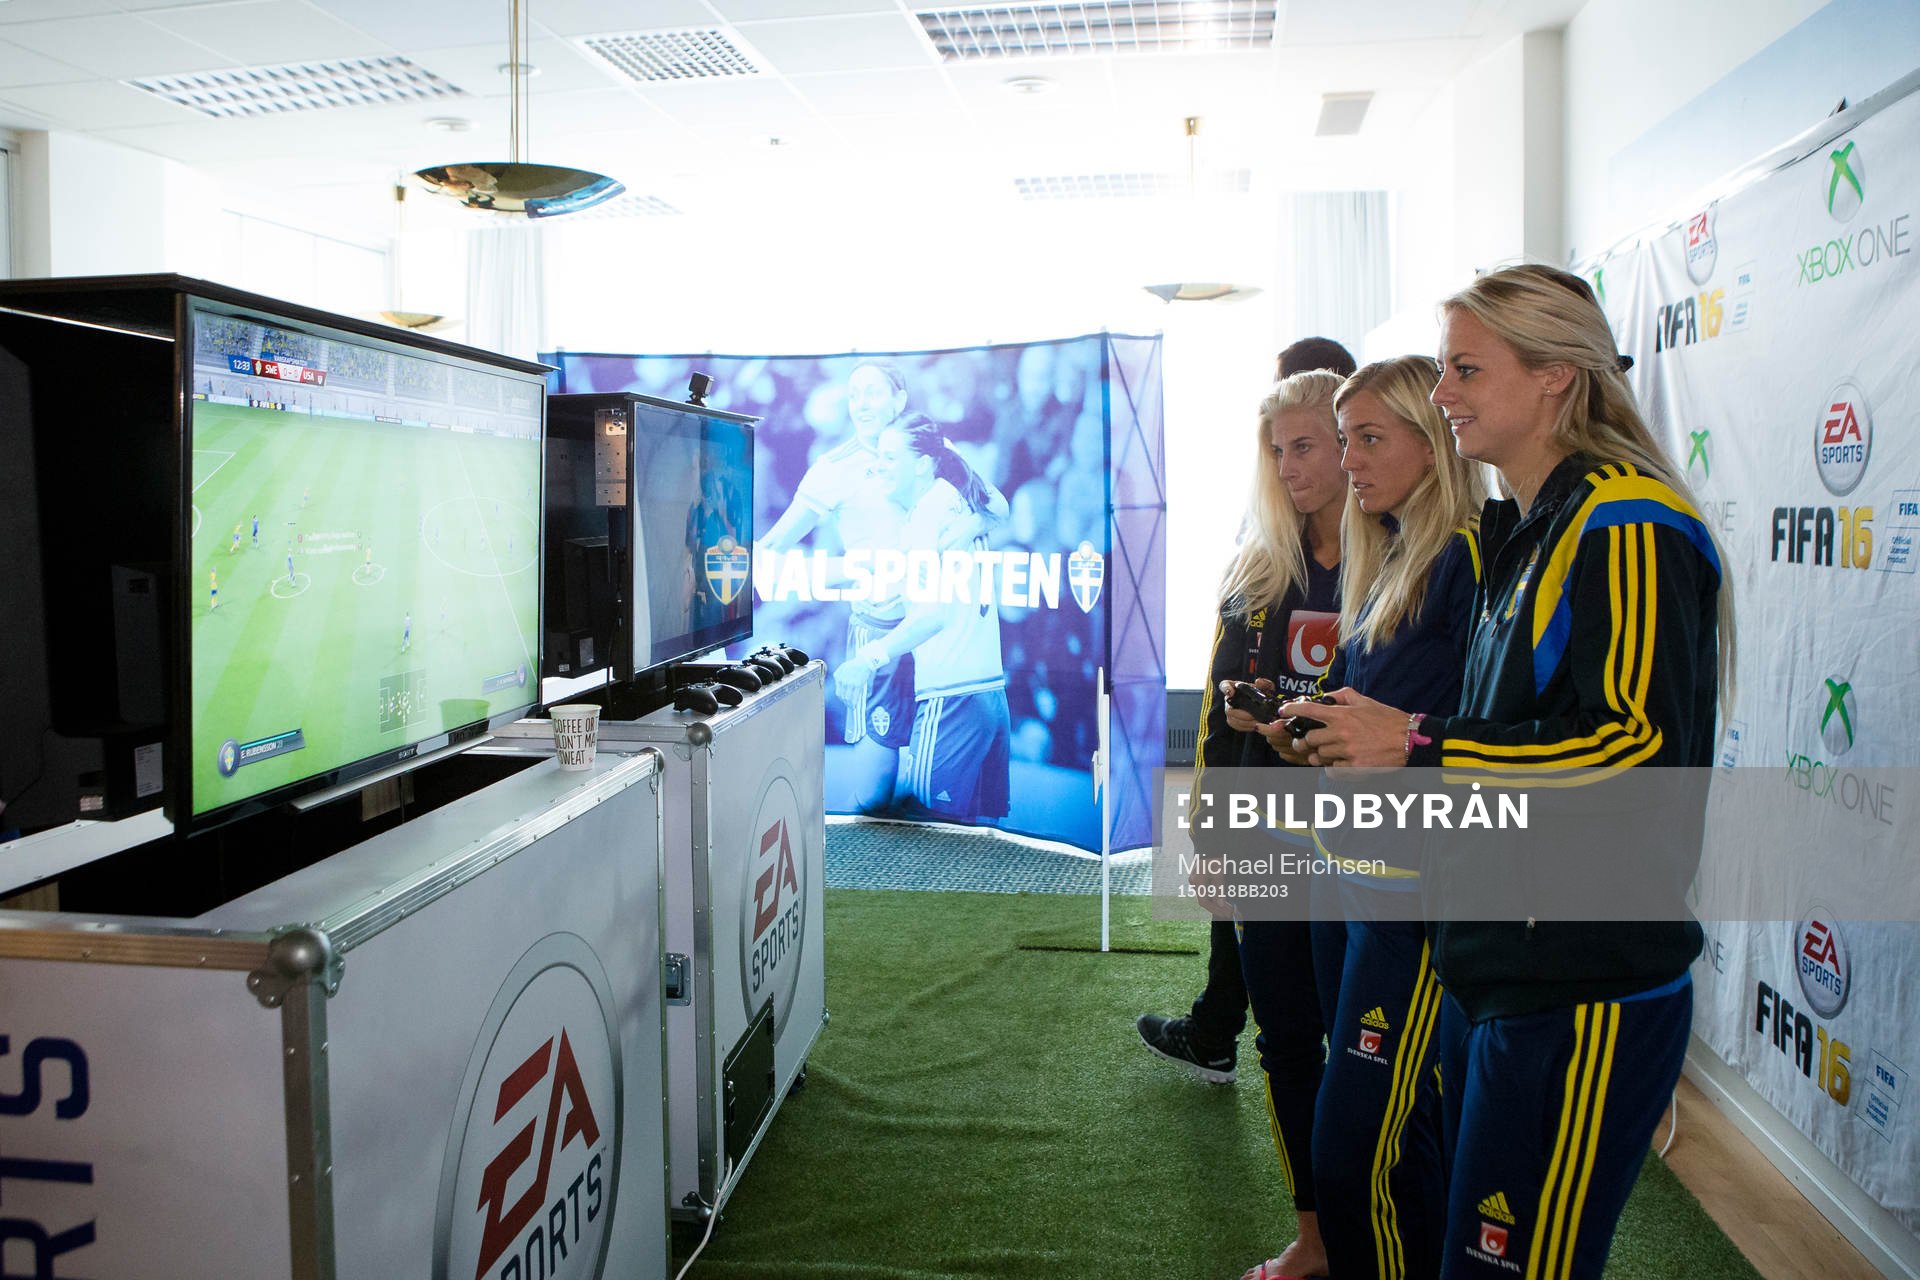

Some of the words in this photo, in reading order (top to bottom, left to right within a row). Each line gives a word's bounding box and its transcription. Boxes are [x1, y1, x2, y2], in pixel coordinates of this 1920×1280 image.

[1796, 234, 1855, 288] XBOX
[1857, 214, 1911, 267] ONE
[1655, 296, 1698, 353] FIFA
[1698, 287, 1725, 342] 16
[265, 364, 278, 375] SWE
[303, 370, 315, 382] USA
[1822, 401, 1862, 444] EA
[1822, 445, 1864, 465] SPORTS
[1899, 503, 1919, 516] FIFA
[1771, 506, 1835, 567] FIFA
[1838, 506, 1874, 570] 16
[553, 718, 582, 734] COFFEE
[585, 717, 595, 733] OR
[1784, 750, 1839, 805] XBOX
[1841, 772, 1895, 826] ONE
[752, 815, 798, 945] EA
[751, 902, 800, 994] SPORTS
[1803, 920, 1841, 976] EA
[1801, 956, 1842, 996] SPORTS
[1360, 1016, 1390, 1030] adidas
[1755, 980, 1814, 1079] FIFA
[1816, 1024, 1851, 1106] 16
[1876, 1064, 1896, 1090] FIFA
[474, 1025, 601, 1280] EA
[1477, 1203, 1516, 1225] adidas
